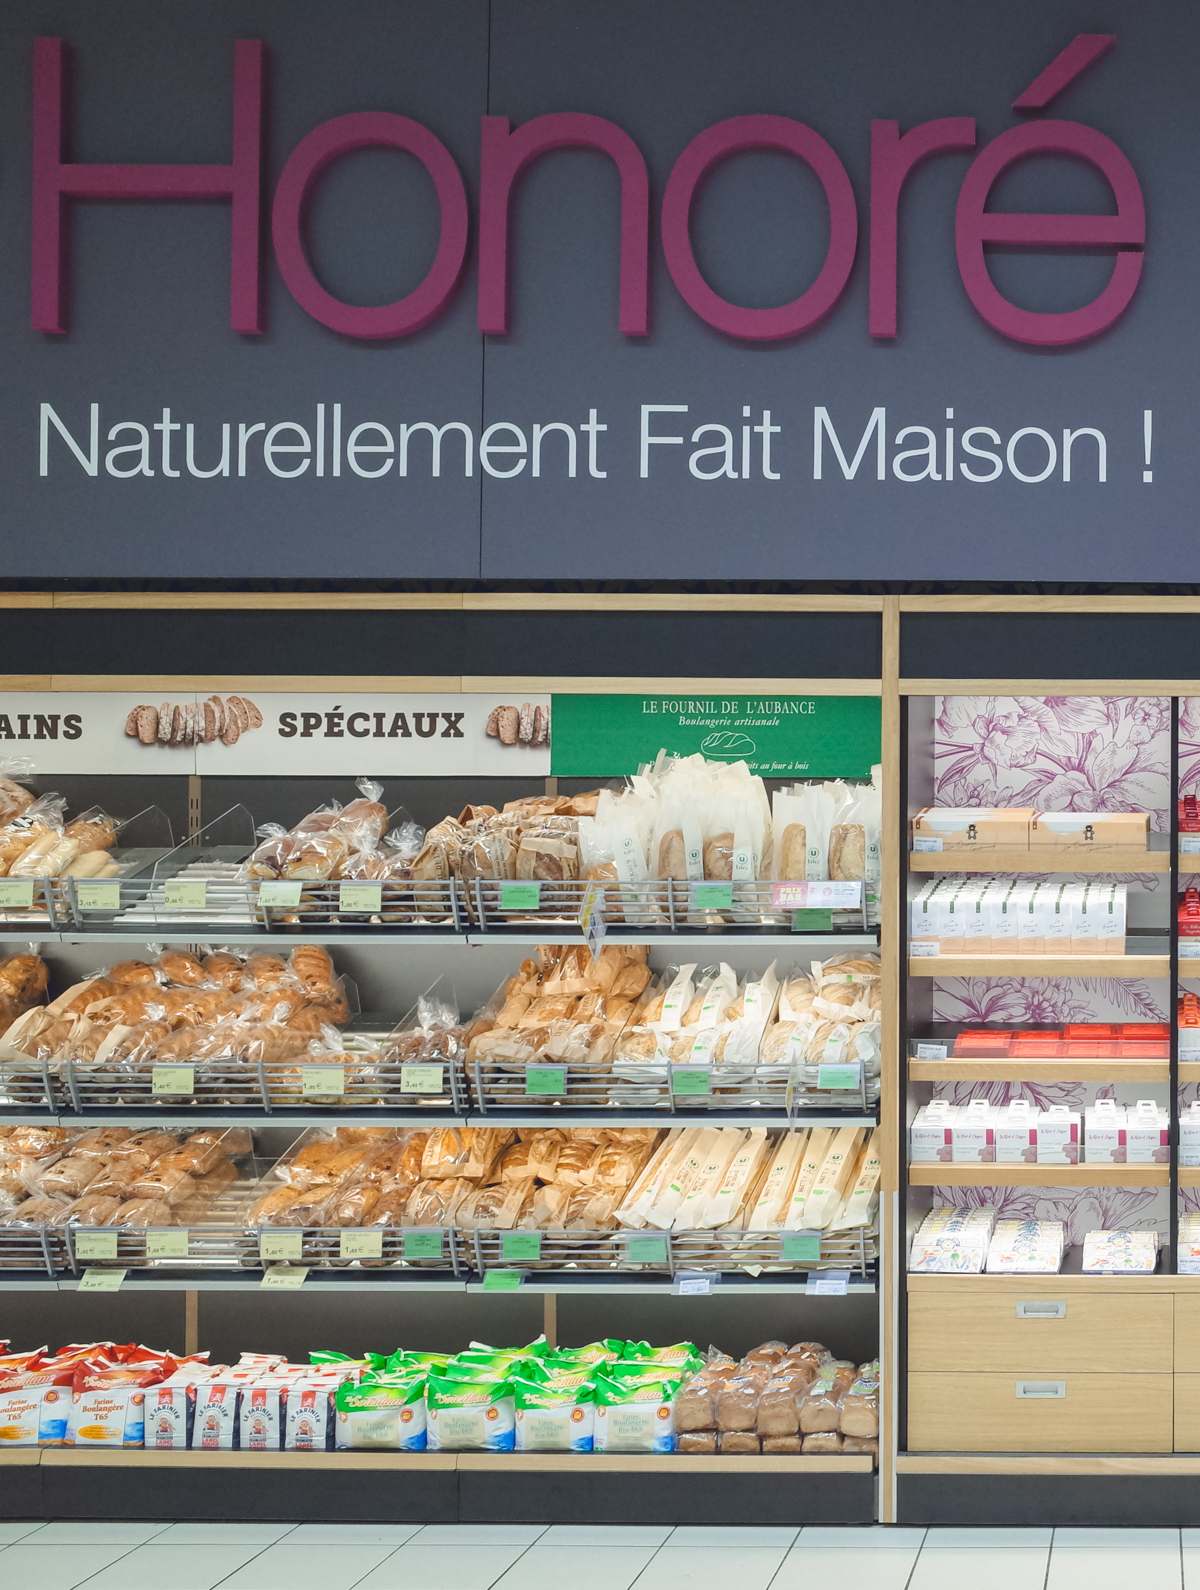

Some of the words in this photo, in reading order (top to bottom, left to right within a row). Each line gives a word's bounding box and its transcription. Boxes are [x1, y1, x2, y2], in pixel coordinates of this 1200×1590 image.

[29, 33, 1147, 348] Honoré
[37, 402, 608, 482] Naturellement
[639, 404, 782, 482] Fait
[812, 406, 1108, 485] Maison
[1142, 410, 1154, 484] !
[642, 701, 658, 714] LE
[662, 700, 718, 714] FOURNIL
[721, 701, 738, 714] DE
[746, 701, 816, 714] L'AUBANCE
[277, 705, 465, 738] SPÉCIAUX
[678, 716, 731, 728] Boulangerie
[734, 716, 780, 726] artisanale
[760, 762, 770, 770] au
[770, 761, 787, 772] four
[788, 762, 793, 770] à
[794, 761, 809, 770] bois
[82, 1404, 124, 1413] Boulangère
[154, 1404, 180, 1420] FARINIER
[203, 1402, 228, 1418] FARINIER
[248, 1406, 273, 1422] FARINIER
[295, 1408, 321, 1423] FARINIER
[7, 1413, 21, 1421] T65
[94, 1413, 108, 1421] T65
